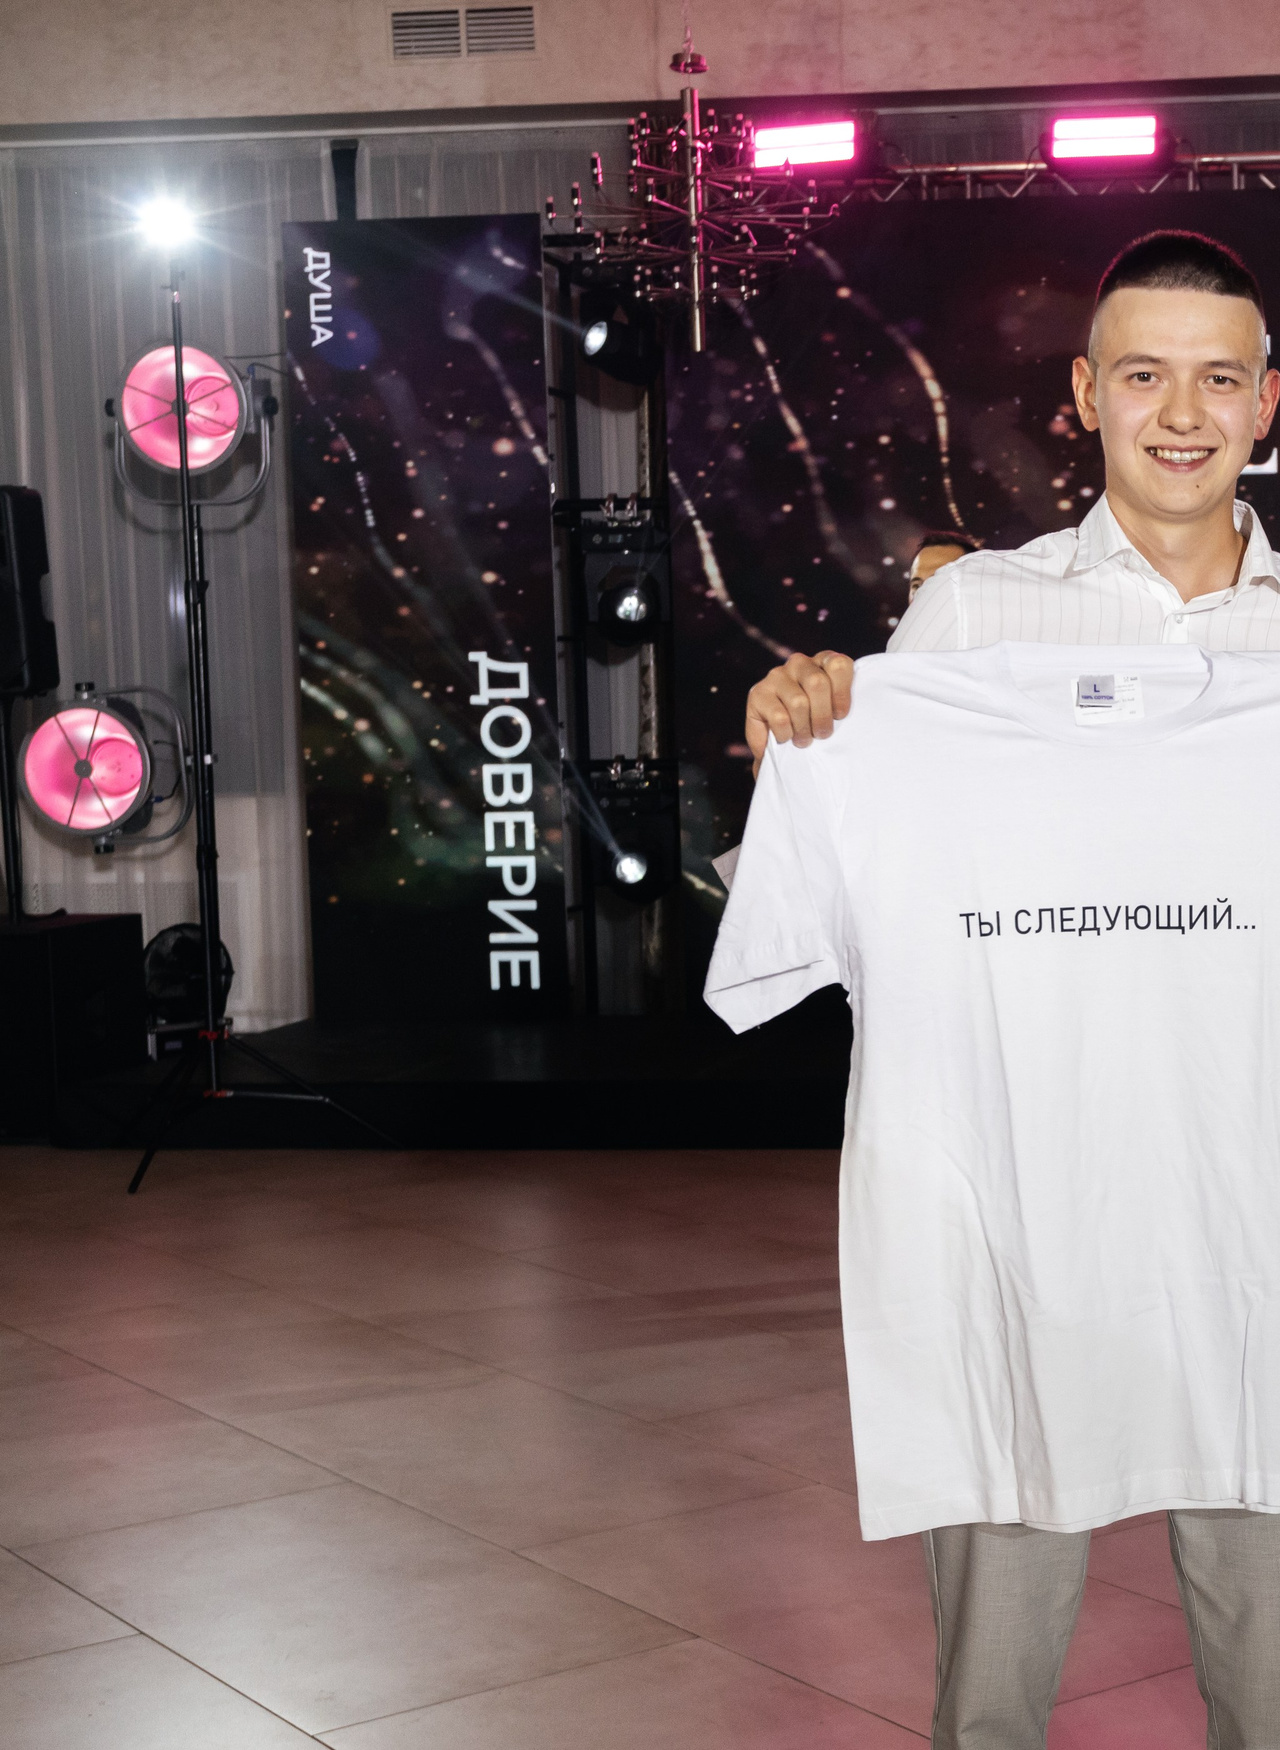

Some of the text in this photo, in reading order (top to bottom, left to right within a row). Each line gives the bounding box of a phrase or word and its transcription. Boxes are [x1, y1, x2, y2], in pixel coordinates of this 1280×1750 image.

[302, 247, 334, 348] ДУША
[1093, 683, 1101, 693] L
[467, 651, 541, 991] ДОВЕРИЕ
[959, 897, 1256, 938] ТЫ СЛЕДУЮЩИЙ...
